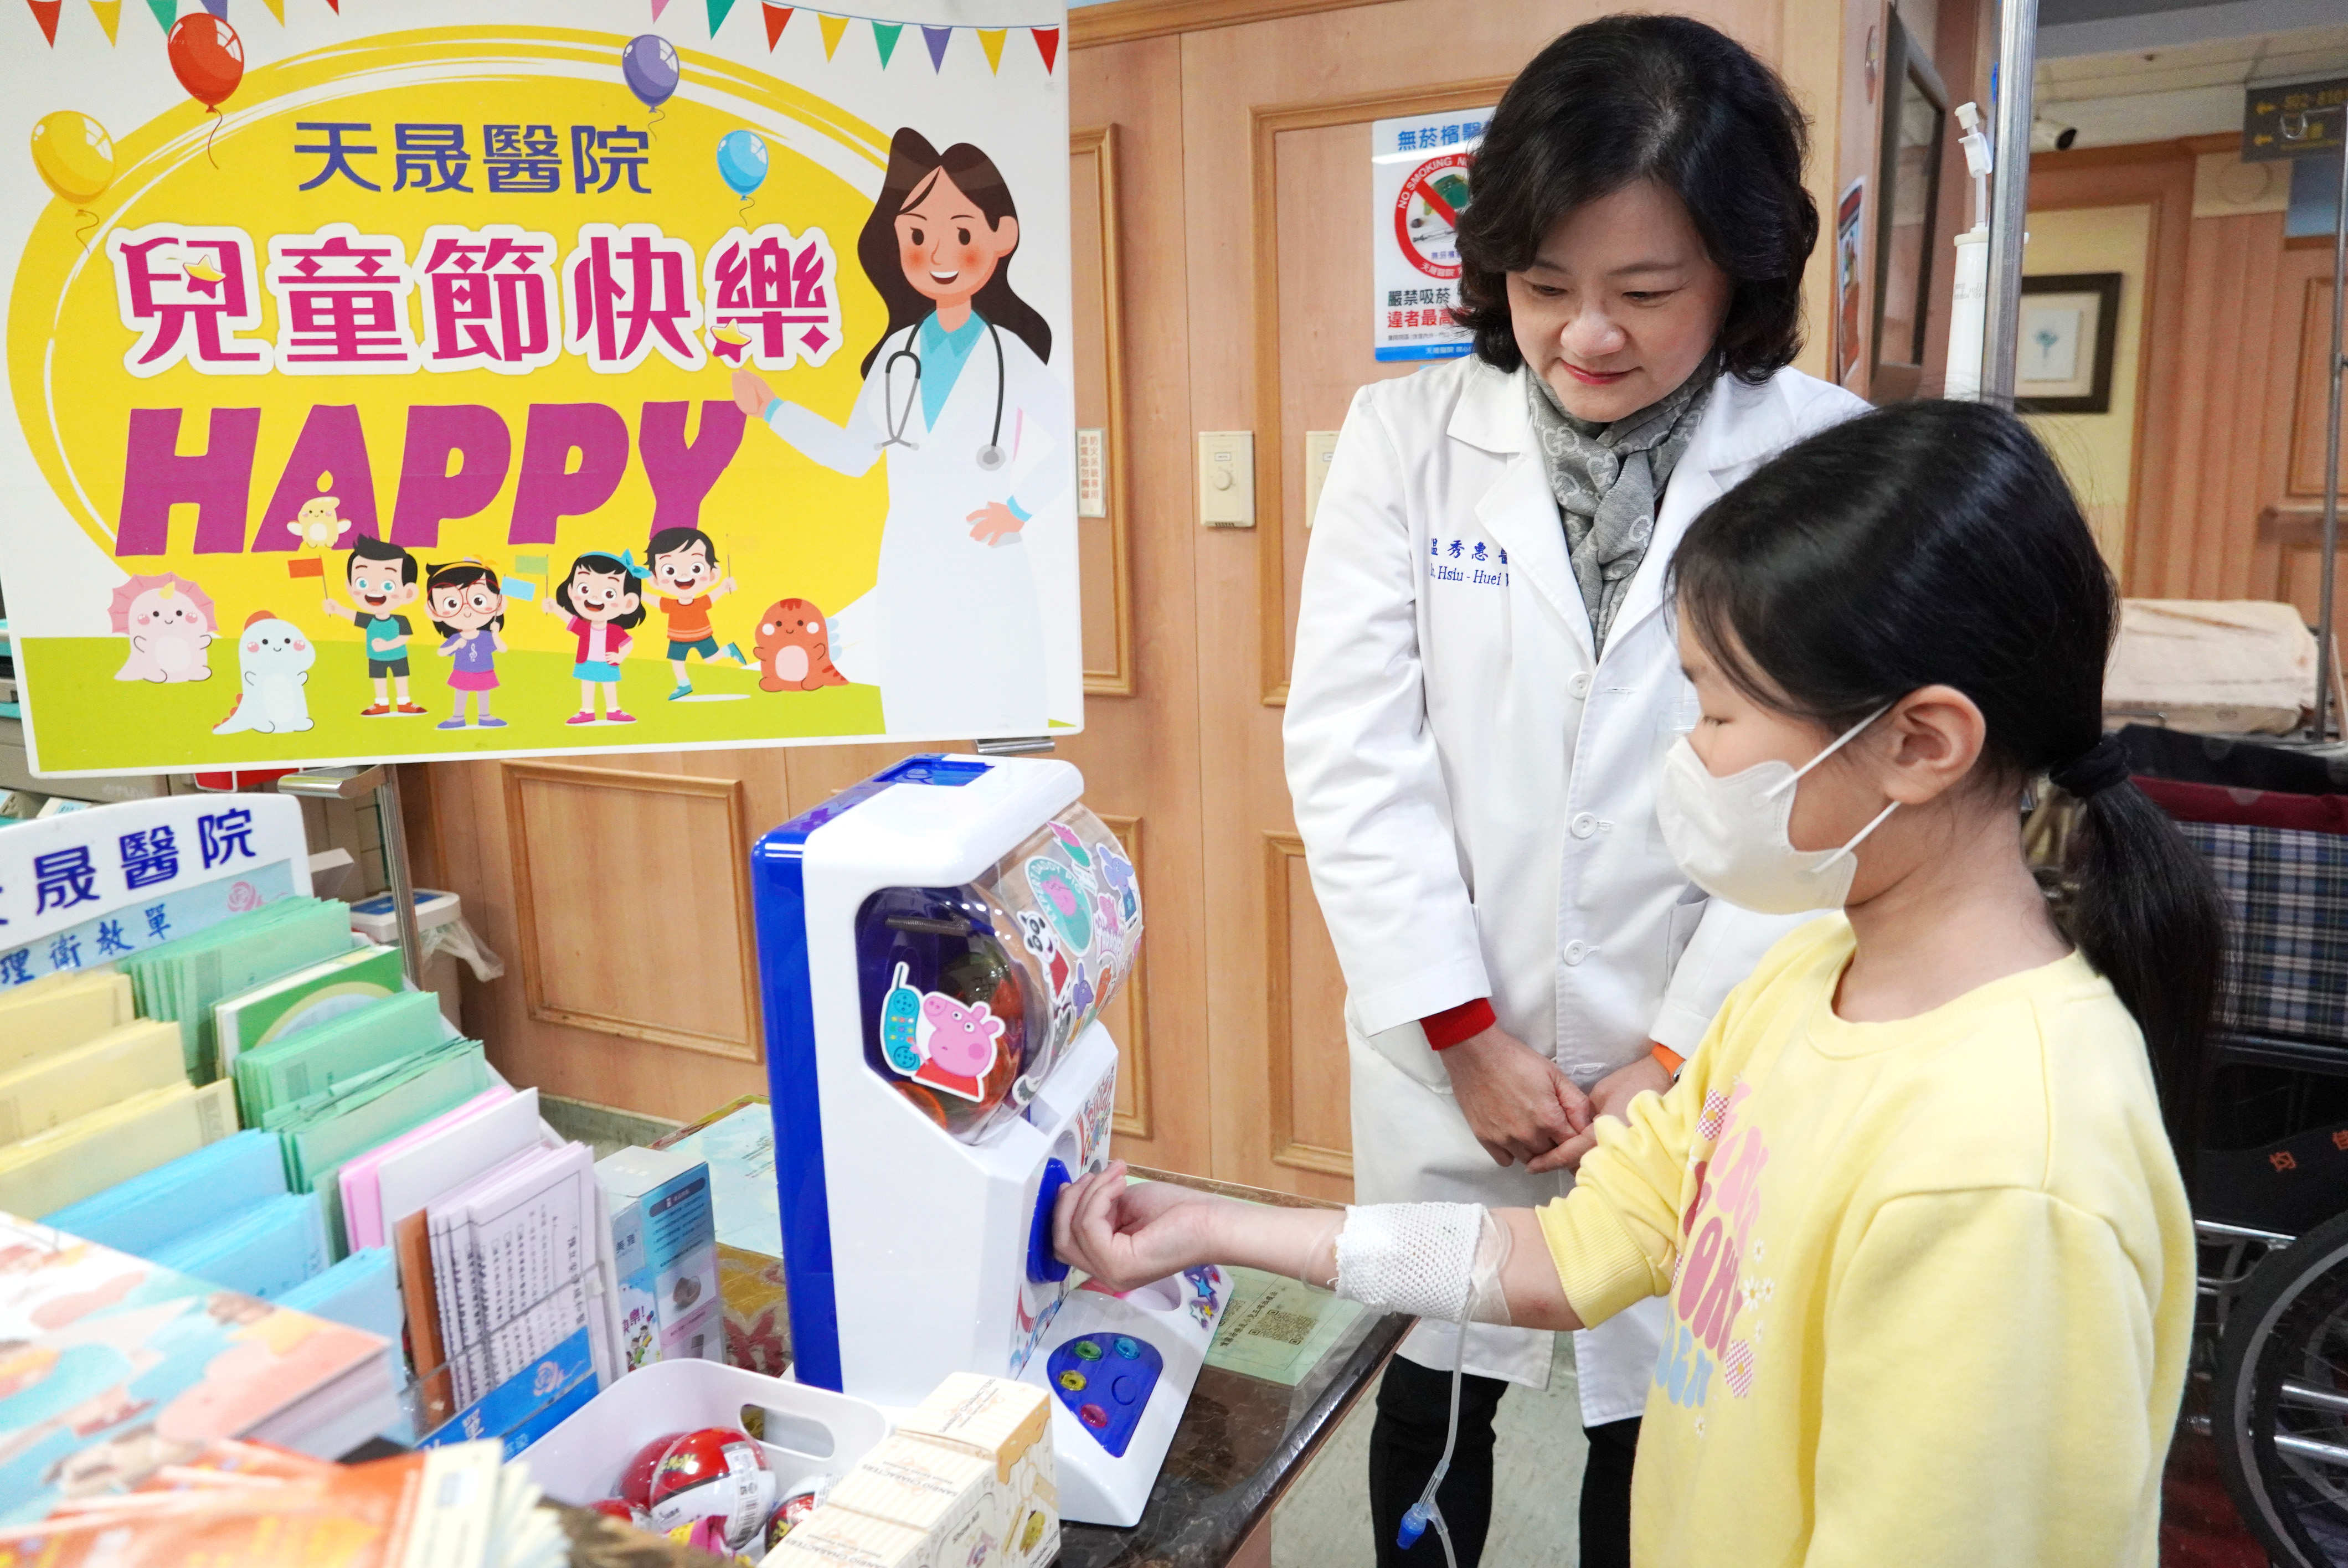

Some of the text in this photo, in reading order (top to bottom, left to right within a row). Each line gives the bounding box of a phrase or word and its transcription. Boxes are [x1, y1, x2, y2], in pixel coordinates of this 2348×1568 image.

[294, 121, 652, 194] 天晟醫院
[1398, 191, 1410, 209] NO
[1407, 157, 1452, 191] SMOKING
[119, 236, 831, 365] 兒童節快樂
[1388, 288, 1450, 306] 嚴禁吸菸
[115, 400, 748, 557] HAPPY
[1438, 566, 1463, 581] Hsiu
[1473, 569, 1501, 585] Huei
[0, 808, 256, 925] 晟醫院
